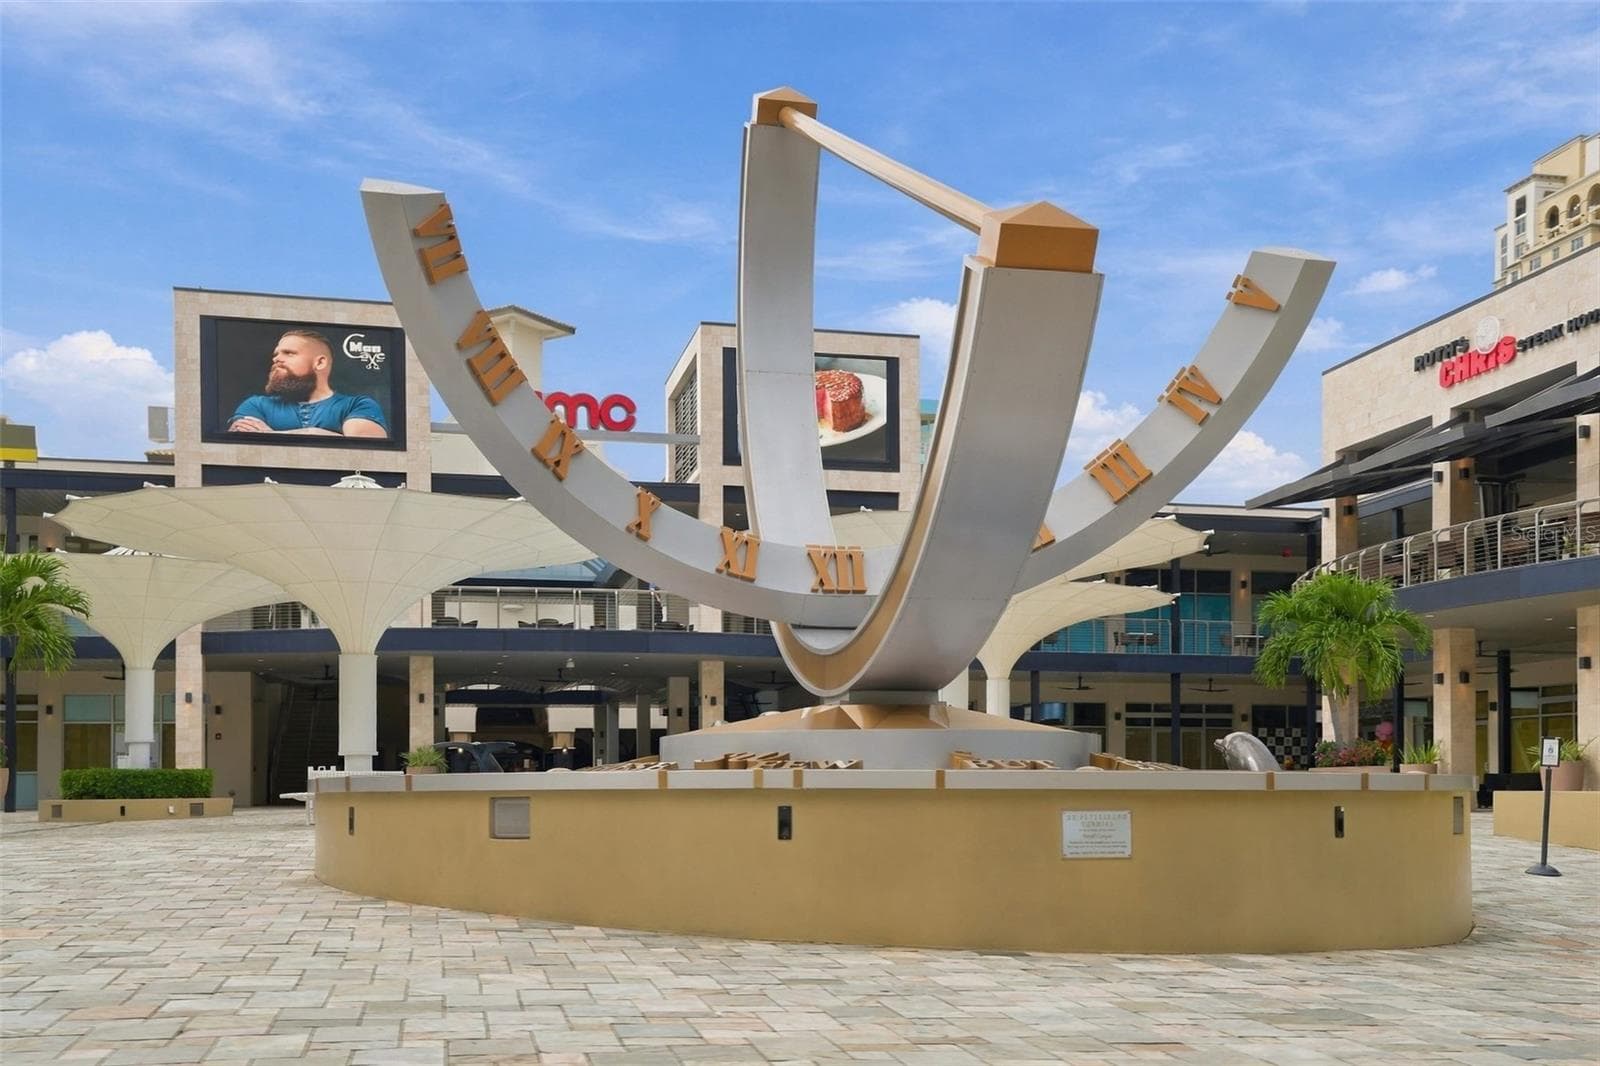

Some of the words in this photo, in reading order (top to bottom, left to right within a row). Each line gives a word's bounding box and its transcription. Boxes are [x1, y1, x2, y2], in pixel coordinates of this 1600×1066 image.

[1225, 274, 1280, 312] V
[1517, 323, 1564, 353] STEAK
[1566, 308, 1600, 333] HOU
[1439, 335, 1516, 389] CHRIS
[535, 391, 636, 432] mc
[531, 414, 584, 481] IX
[1083, 438, 1153, 505] III
[626, 486, 662, 542] X
[715, 525, 761, 583] XI
[805, 544, 868, 594] XII
